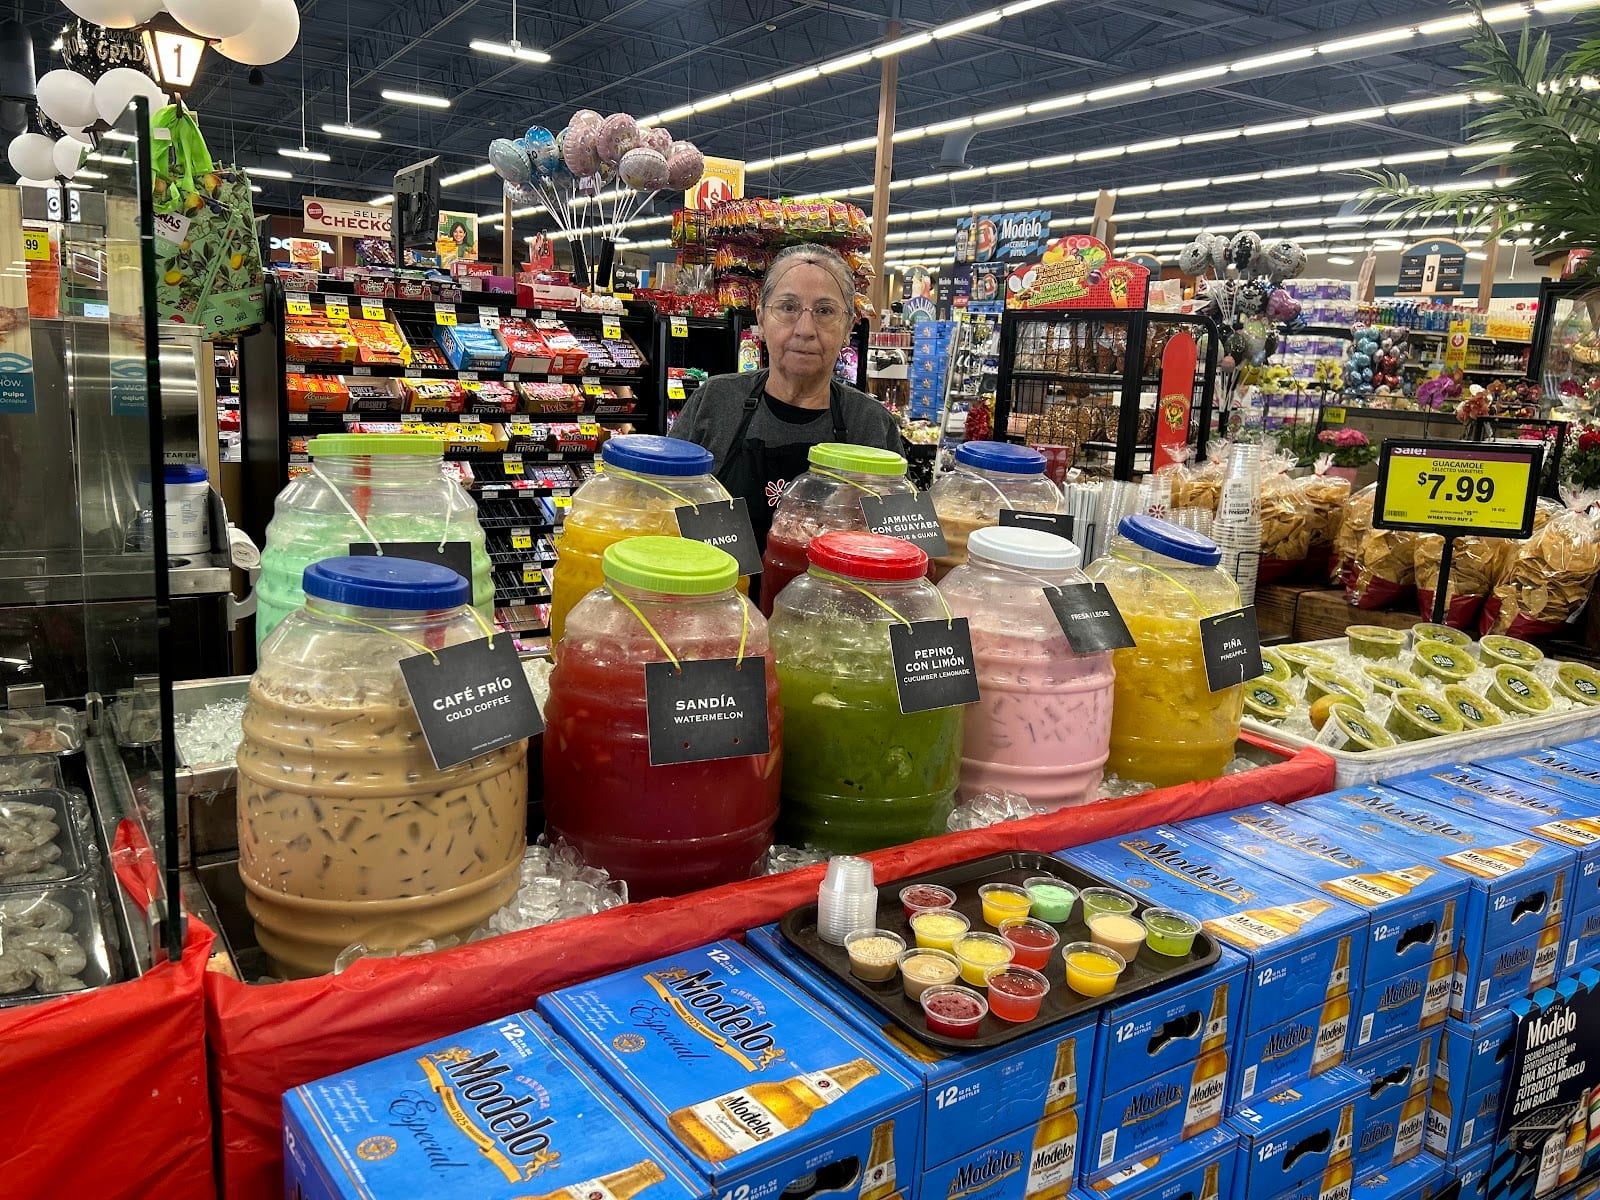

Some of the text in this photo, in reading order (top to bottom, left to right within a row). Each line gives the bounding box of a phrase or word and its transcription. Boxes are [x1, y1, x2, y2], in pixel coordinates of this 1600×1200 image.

[96, 39, 145, 63] GRAD
[173, 43, 182, 78] 1
[320, 215, 392, 232] CHECKO
[353, 210, 384, 220] SELF
[1001, 217, 1042, 239] Modelo
[1426, 265, 1435, 282] 3
[1432, 460, 1484, 470] GUACAMOLE
[1417, 471, 1495, 503] $7.99
[871, 520, 940, 535] CON GUAYABA
[882, 513, 925, 525] JAMAICA
[703, 534, 738, 547] MANGO
[917, 531, 939, 540] GUAVA
[1092, 610, 1111, 618] LECHE
[914, 646, 955, 660] PEPINO
[1219, 647, 1248, 662] PINEAPPLE
[1223, 638, 1243, 651] PIÑA
[905, 654, 965, 673] CON LIMÓN
[903, 668, 971, 684] CUCUMBER LEMONADE
[432, 675, 513, 711] CAFÉ FRÍO
[675, 694, 737, 711] SANDÍA
[445, 694, 512, 723] COLD COFFEE
[673, 711, 744, 724] WATERMELON
[1450, 773, 1549, 810] Modelo
[1363, 795, 1461, 838] Modelo
[1156, 829, 1174, 840] 12
[1252, 814, 1356, 863] Modelo
[1147, 842, 1246, 895] Modelo
[1464, 850, 1510, 872] Modelo
[1583, 862, 1595, 876] 12
[1347, 877, 1393, 900] Modelo
[1494, 895, 1505, 911] 12
[1236, 915, 1281, 940] Modelo
[1374, 925, 1388, 942] 12
[706, 948, 726, 965] 12
[1498, 948, 1529, 968] Modelo
[1535, 947, 1557, 962] Modelo
[1257, 967, 1273, 986] 12
[1384, 980, 1418, 1005] Modelo
[1427, 979, 1451, 996] Modelo
[670, 969, 777, 1053] Modelo
[684, 1013, 701, 1029] 1925
[498, 1022, 526, 1042] 12
[629, 998, 710, 1068] Especial
[1116, 1022, 1135, 1043] 12
[1134, 1025, 1152, 1038] BOTTLES
[1268, 1025, 1308, 1053] Modelo
[1318, 1023, 1346, 1043] Modelo
[1526, 1008, 1576, 1052] Modelo
[1477, 1038, 1490, 1055] 12
[1523, 1038, 1568, 1064] ESCANEA PARA UNA
[1522, 1042, 1576, 1073] OPORTUNIDAD DE GANAR
[1520, 1055, 1568, 1087] UNA MESA DE
[1192, 1080, 1224, 1103] Modelo
[1516, 1076, 1557, 1102] FÚTBOLITO
[1556, 1061, 1586, 1085] MODELO
[441, 1049, 552, 1157] Modelo
[936, 1085, 959, 1109] 12
[958, 1089, 981, 1102] BOTTLES
[1129, 1082, 1178, 1116] Modelo
[1513, 1085, 1560, 1115] O UN BALÓN!
[451, 1109, 468, 1127] 1925
[724, 1095, 771, 1137] Modelo
[388, 1089, 470, 1178] Especial
[1397, 1118, 1422, 1136] Modelo
[1034, 1142, 1073, 1170] Modelo
[1257, 1143, 1273, 1162] 12
[955, 1150, 1016, 1188] Modelo
[1461, 1170, 1473, 1187] 12
[720, 1183, 750, 1200] 12
[758, 1184, 766, 1192] FL
[768, 1178, 778, 1187] OZ
[750, 1184, 778, 1200] BOTTLES
